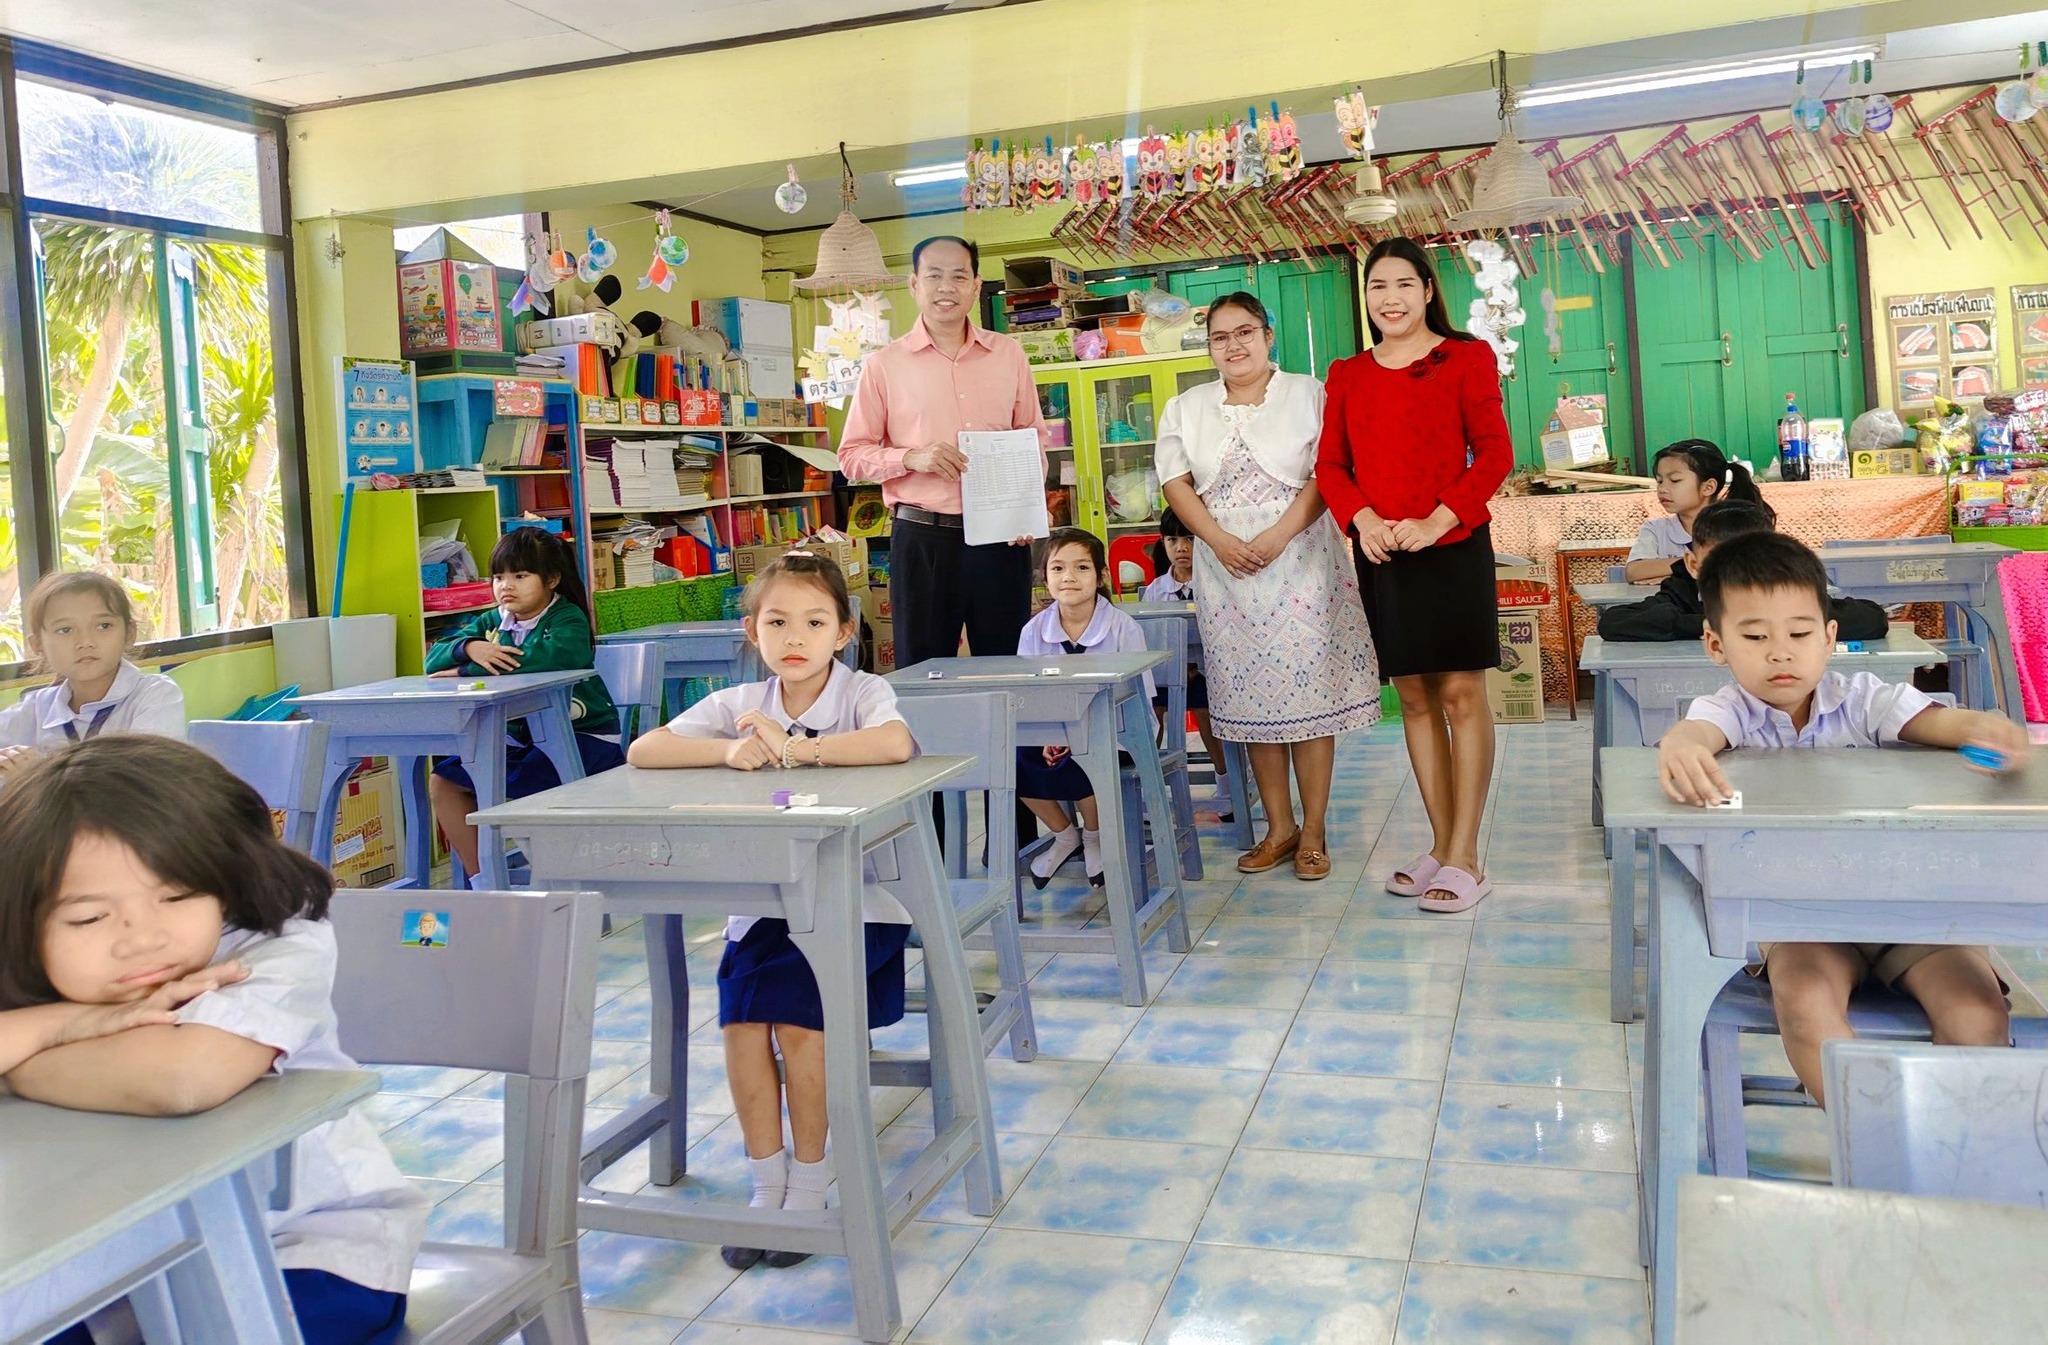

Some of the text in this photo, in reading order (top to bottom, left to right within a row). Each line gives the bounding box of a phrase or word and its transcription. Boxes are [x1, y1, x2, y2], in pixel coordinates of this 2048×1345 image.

[353, 369, 360, 382] 7
[809, 380, 837, 396] ตรง
[370, 394, 376, 404] 2
[391, 395, 397, 405] 3
[371, 428, 377, 438] 5
[741, 556, 751, 564] 12
[1528, 566, 1547, 575] 319
[1515, 595, 1543, 605] SAUCE
[1511, 626, 1530, 637] 20
